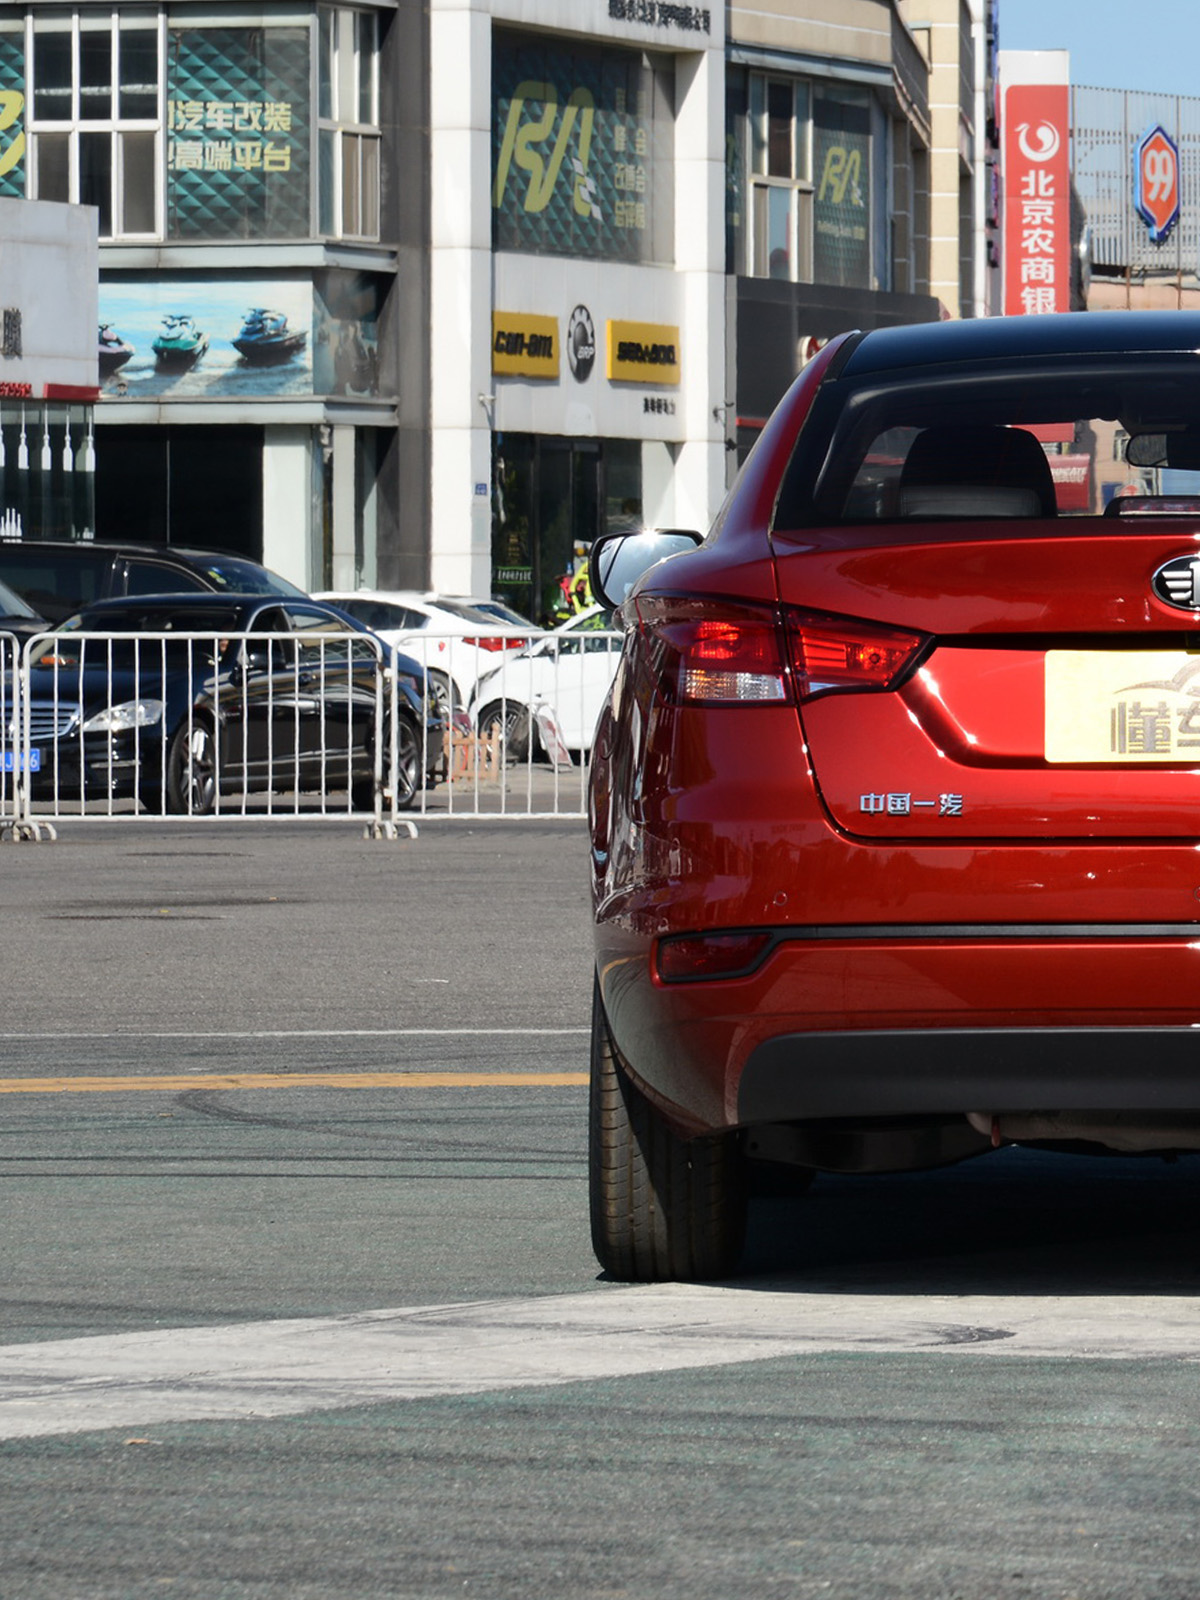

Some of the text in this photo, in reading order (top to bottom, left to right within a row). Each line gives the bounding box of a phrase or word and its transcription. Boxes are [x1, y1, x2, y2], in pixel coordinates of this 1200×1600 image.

[168, 100, 292, 131] 汽车改装
[168, 141, 292, 172] 高端平台
[1144, 148, 1174, 202] 99
[1020, 168, 1056, 315] 北京农商银
[577, 345, 595, 360] BRP
[860, 792, 964, 816] 中国一汽
